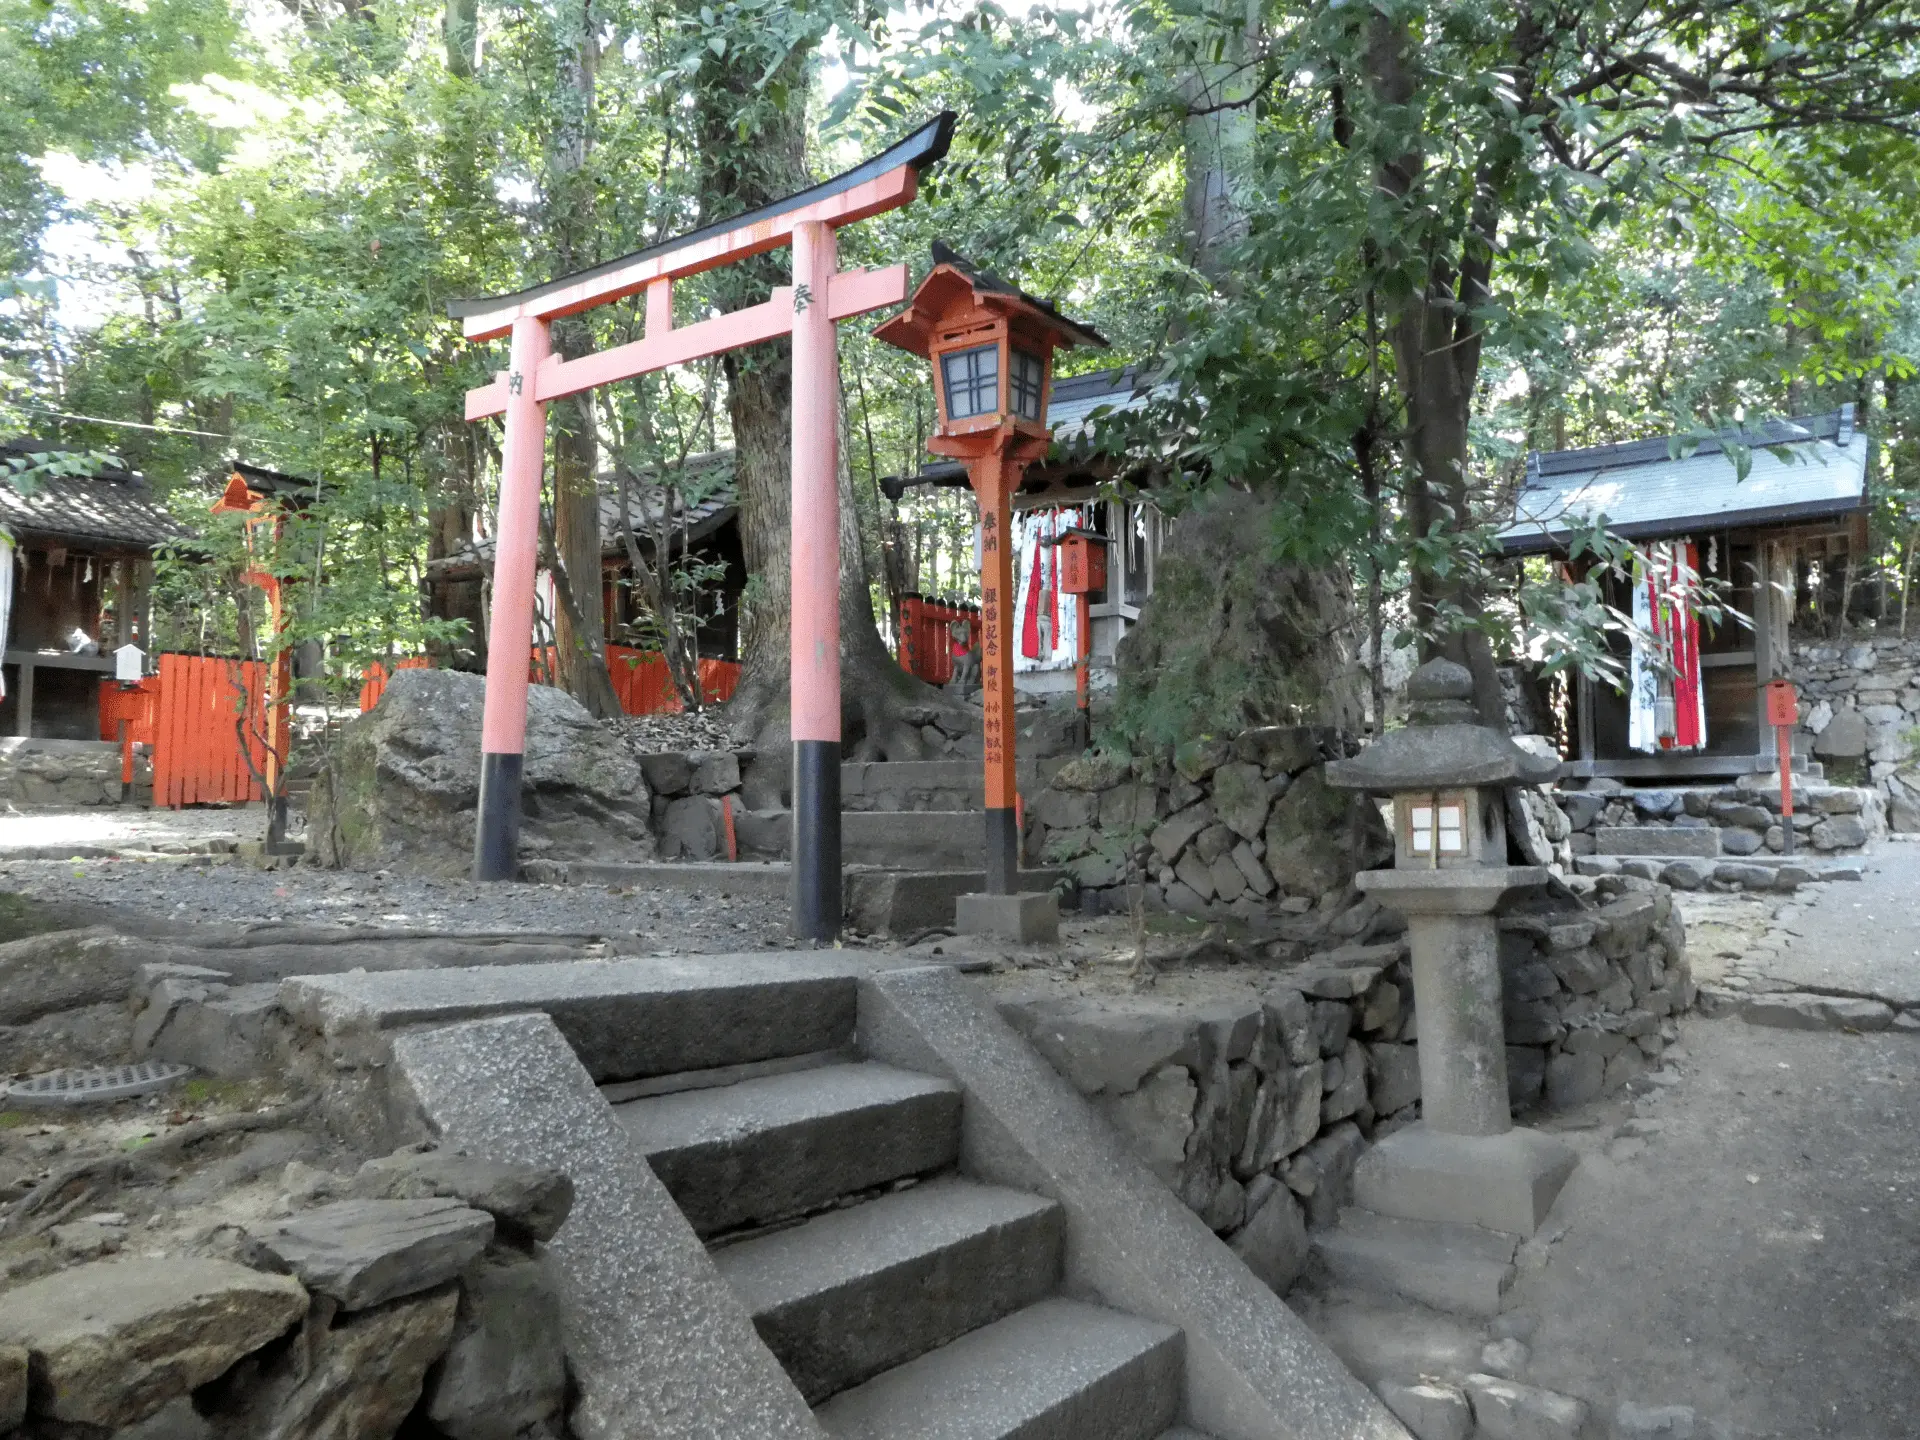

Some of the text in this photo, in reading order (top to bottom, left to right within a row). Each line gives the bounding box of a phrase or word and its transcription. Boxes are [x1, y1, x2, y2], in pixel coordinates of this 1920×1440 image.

[793, 283, 816, 316] 奉
[983, 510, 998, 552] 奉納
[984, 587, 999, 657] 銀婚記念
